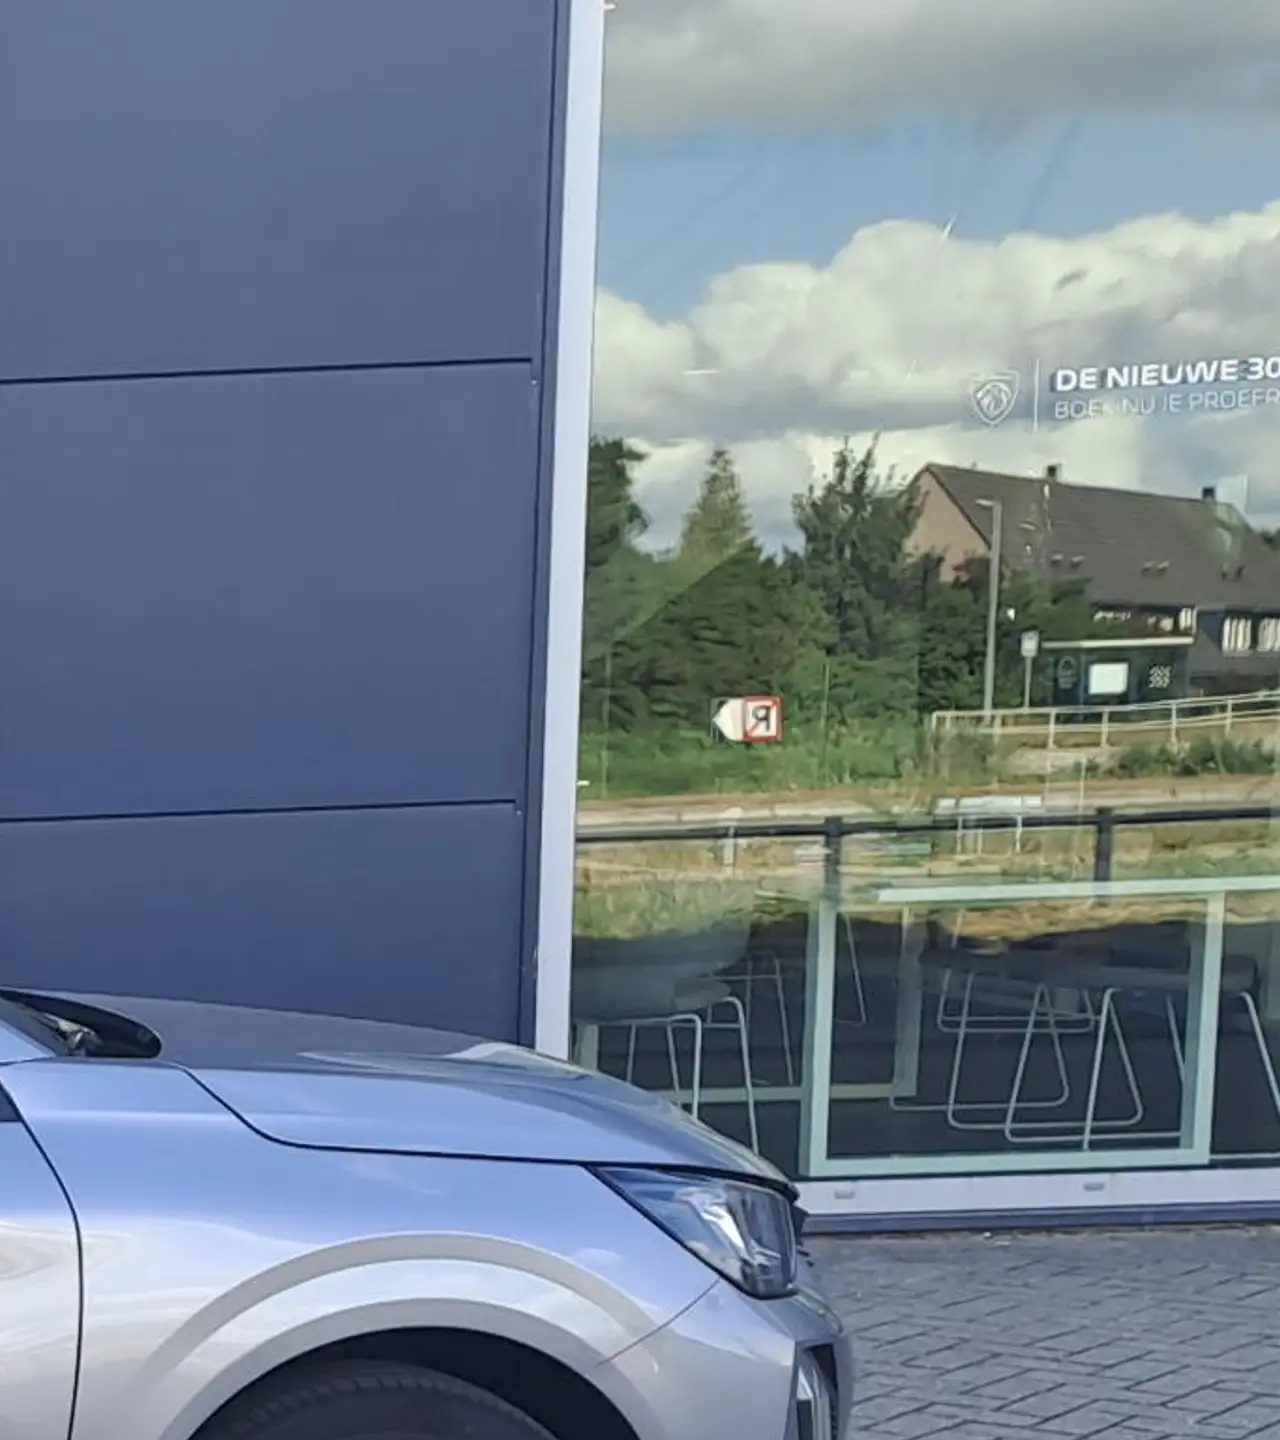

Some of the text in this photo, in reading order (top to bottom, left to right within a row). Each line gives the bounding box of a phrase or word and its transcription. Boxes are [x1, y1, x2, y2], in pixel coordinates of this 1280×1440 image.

[1056, 356, 1280, 392] DE NIEUWE 30
